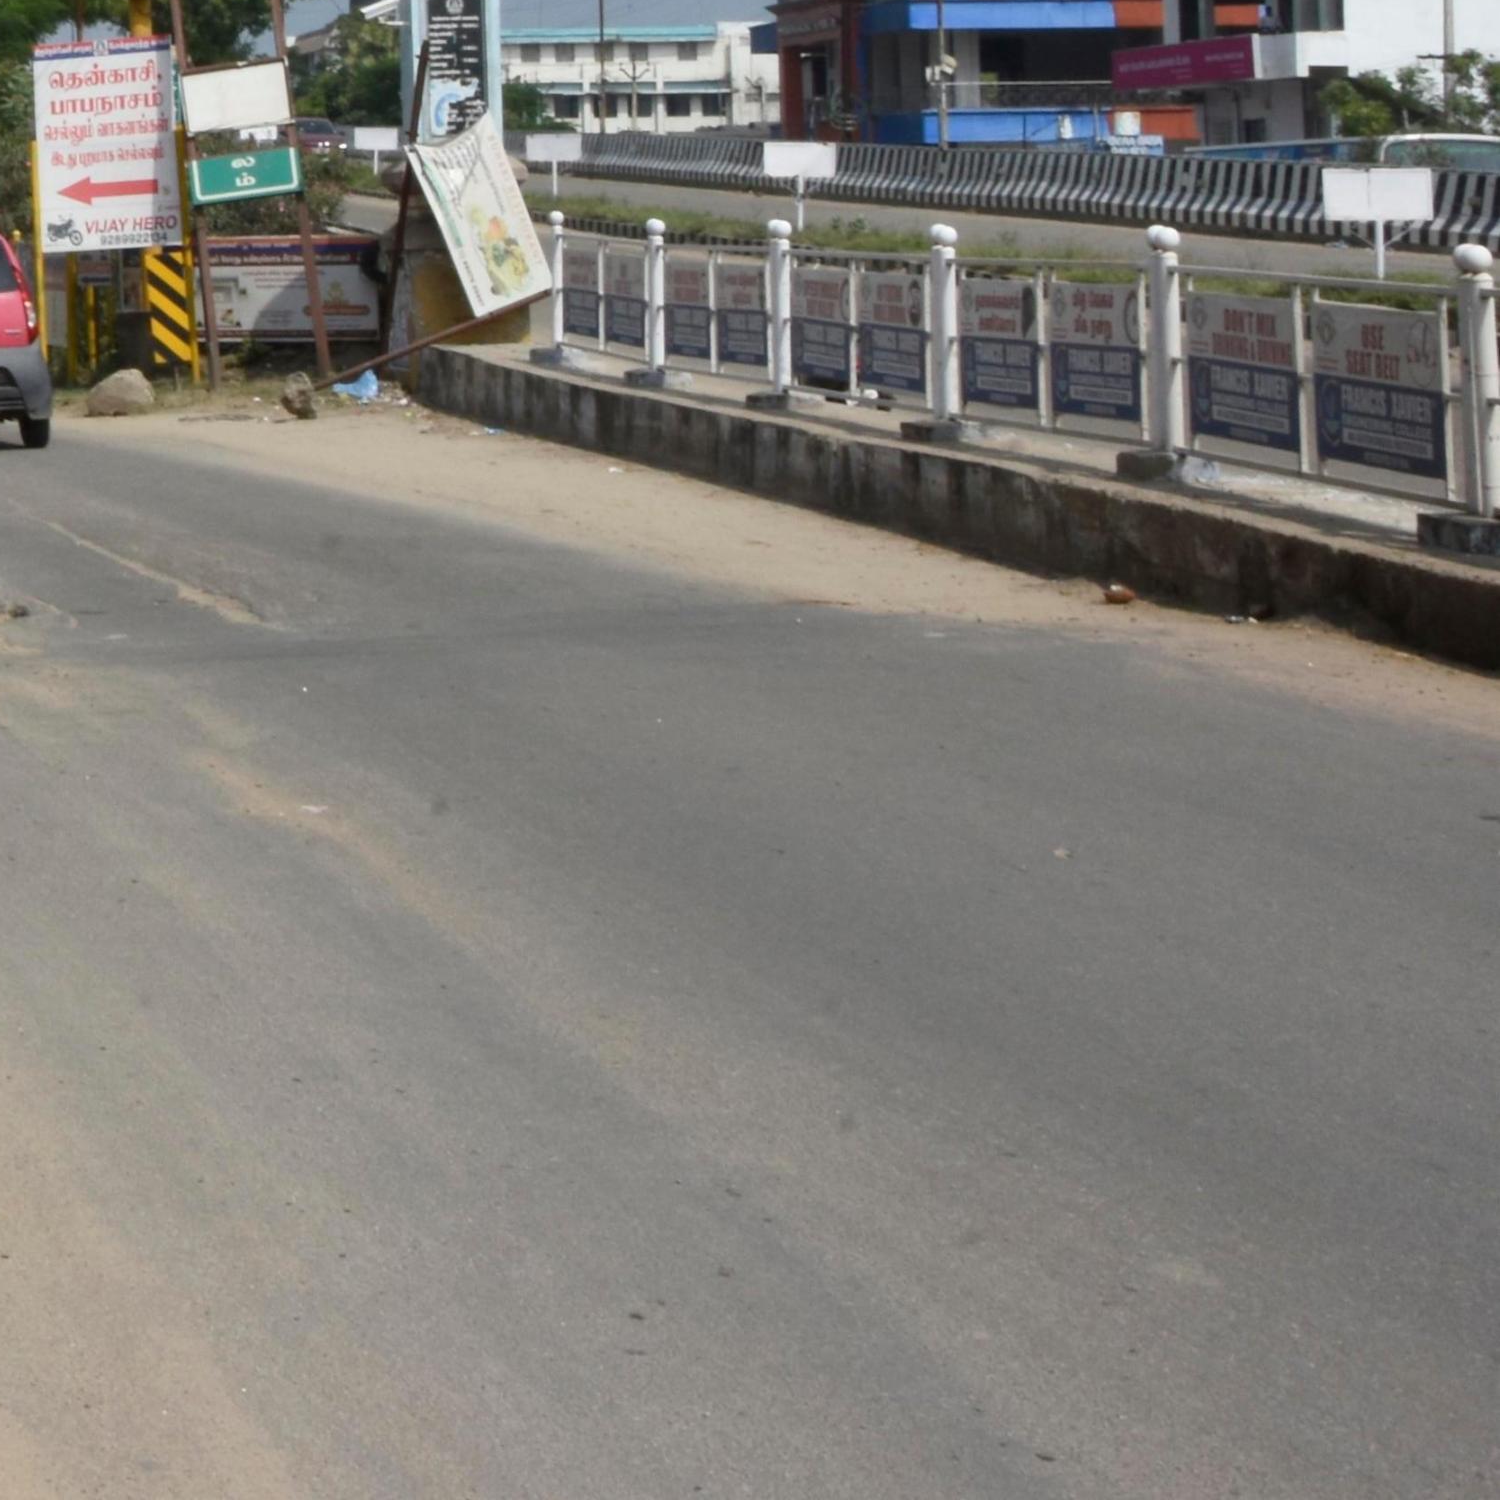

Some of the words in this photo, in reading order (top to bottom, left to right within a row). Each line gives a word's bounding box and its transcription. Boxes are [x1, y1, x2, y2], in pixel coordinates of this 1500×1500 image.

[50, 85, 164, 117] பாபநாசம்
[85, 218, 128, 234] VIJAY
[132, 214, 177, 231] HERO
